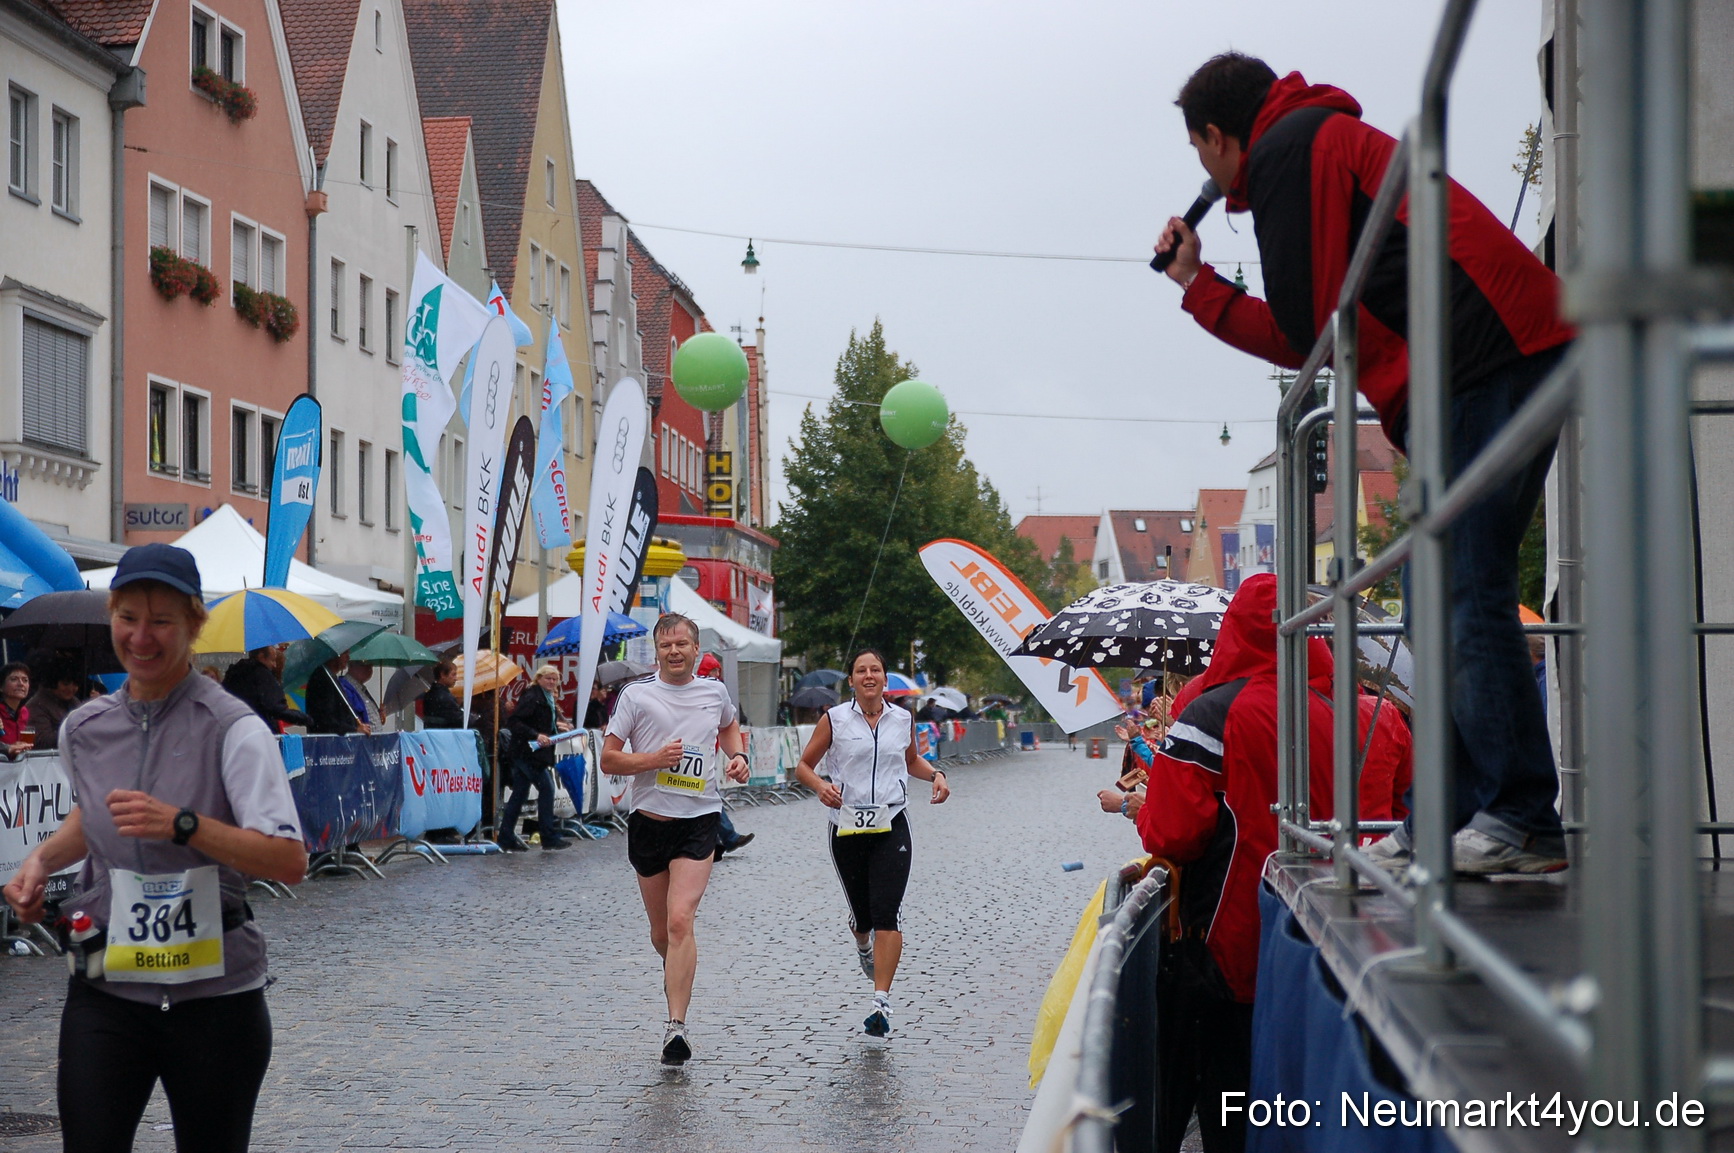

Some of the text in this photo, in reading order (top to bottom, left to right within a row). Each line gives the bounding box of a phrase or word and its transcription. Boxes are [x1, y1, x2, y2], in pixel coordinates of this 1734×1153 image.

[472, 451, 492, 598] Audi BKK
[489, 454, 530, 616] HULE
[592, 491, 617, 614] Audi BKK
[608, 502, 651, 614] HULE
[667, 776, 700, 789] Reimund
[855, 811, 876, 828] 32
[128, 899, 197, 943] 384
[136, 952, 190, 968] Bettina
